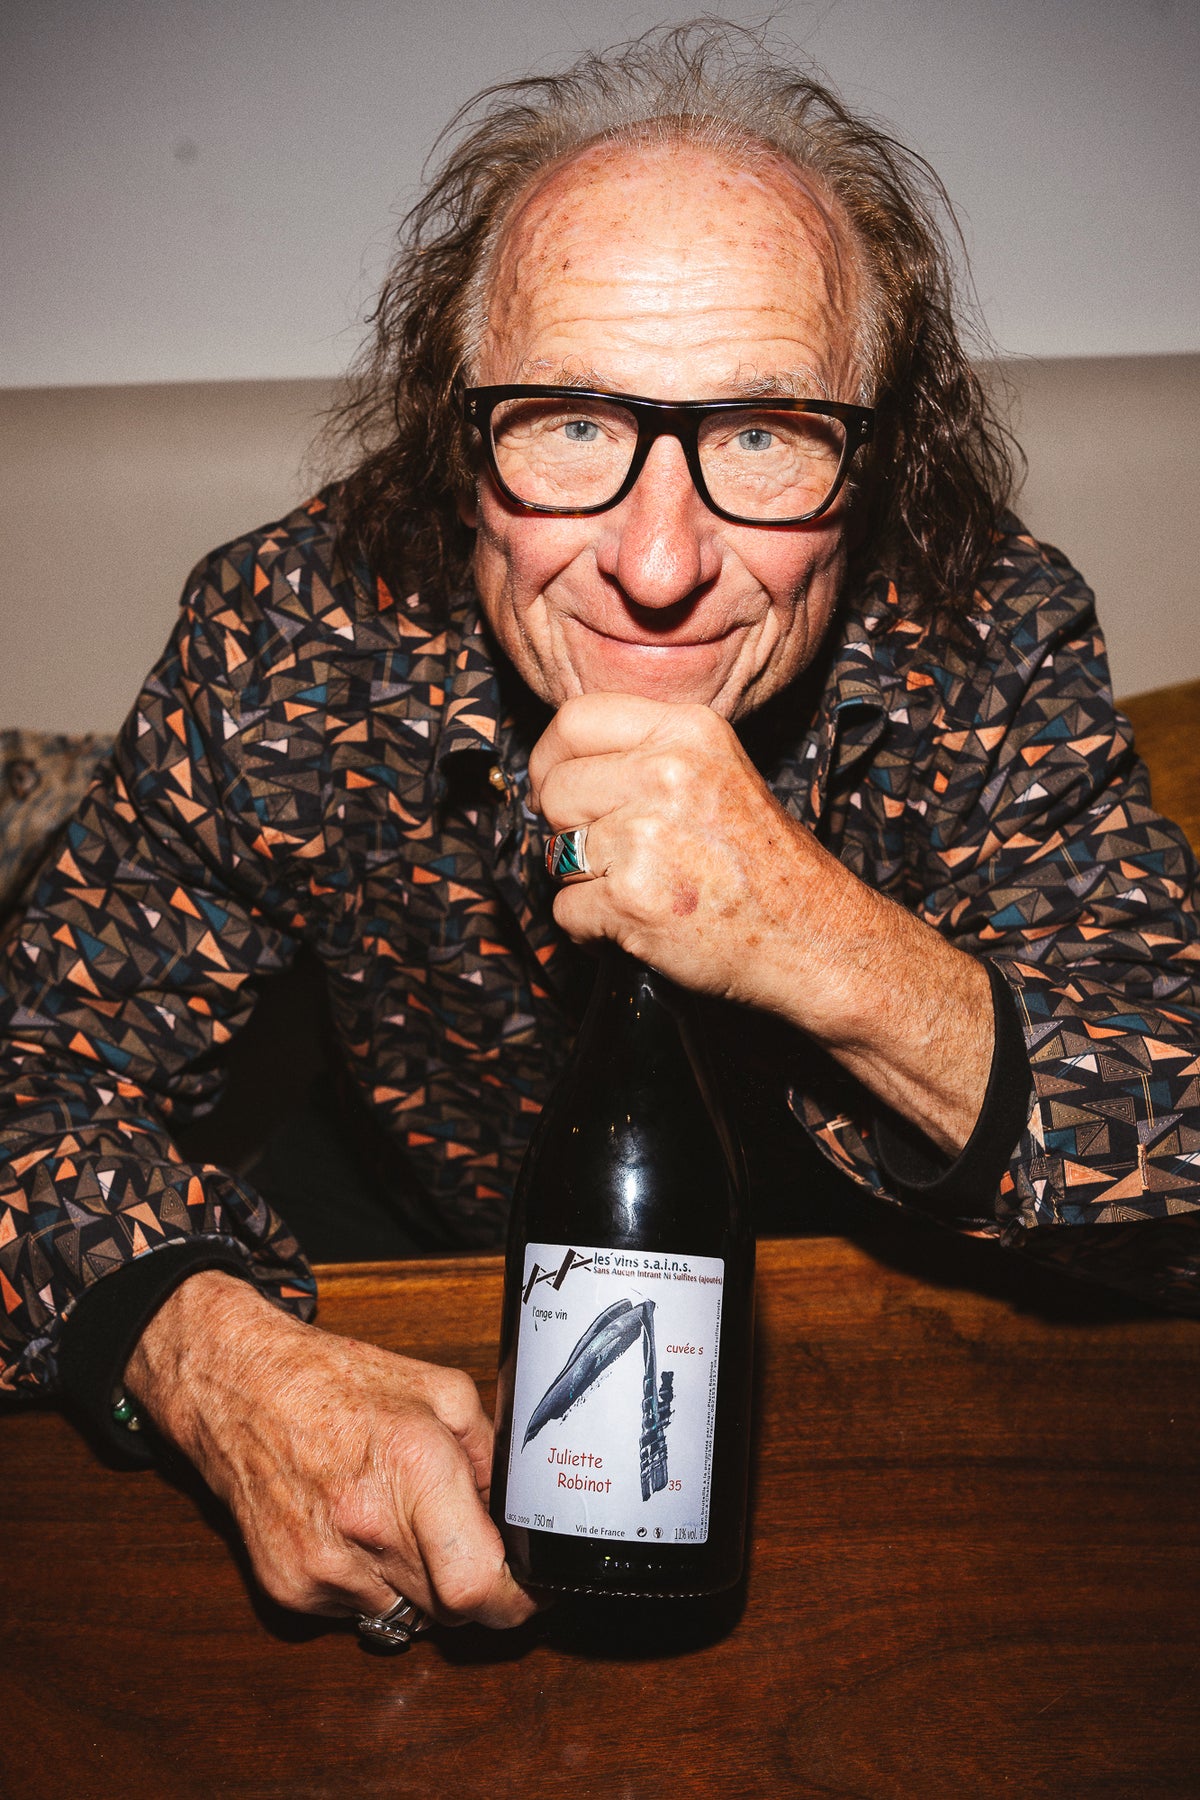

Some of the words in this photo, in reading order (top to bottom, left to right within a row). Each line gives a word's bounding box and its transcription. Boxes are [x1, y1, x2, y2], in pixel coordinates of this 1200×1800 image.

[614, 1255, 639, 1268] vins
[643, 1258, 691, 1273] s.a.i.n.s.
[593, 1265, 610, 1275] Sans
[611, 1267, 635, 1277] Aucun
[637, 1269, 661, 1279] Intrant
[663, 1272, 671, 1280] Ni
[672, 1272, 697, 1282] Sulfites
[555, 1310, 568, 1321] vin
[666, 1342, 696, 1355] cuvée
[698, 1346, 704, 1355] s
[547, 1447, 603, 1469] Juliette
[557, 1472, 612, 1493] Robinot
[668, 1480, 682, 1491] 35
[517, 1515, 530, 1525] 2009
[533, 1513, 546, 1528] 750
[575, 1524, 587, 1534] Vin
[589, 1526, 599, 1535] de
[600, 1528, 625, 1538] France
